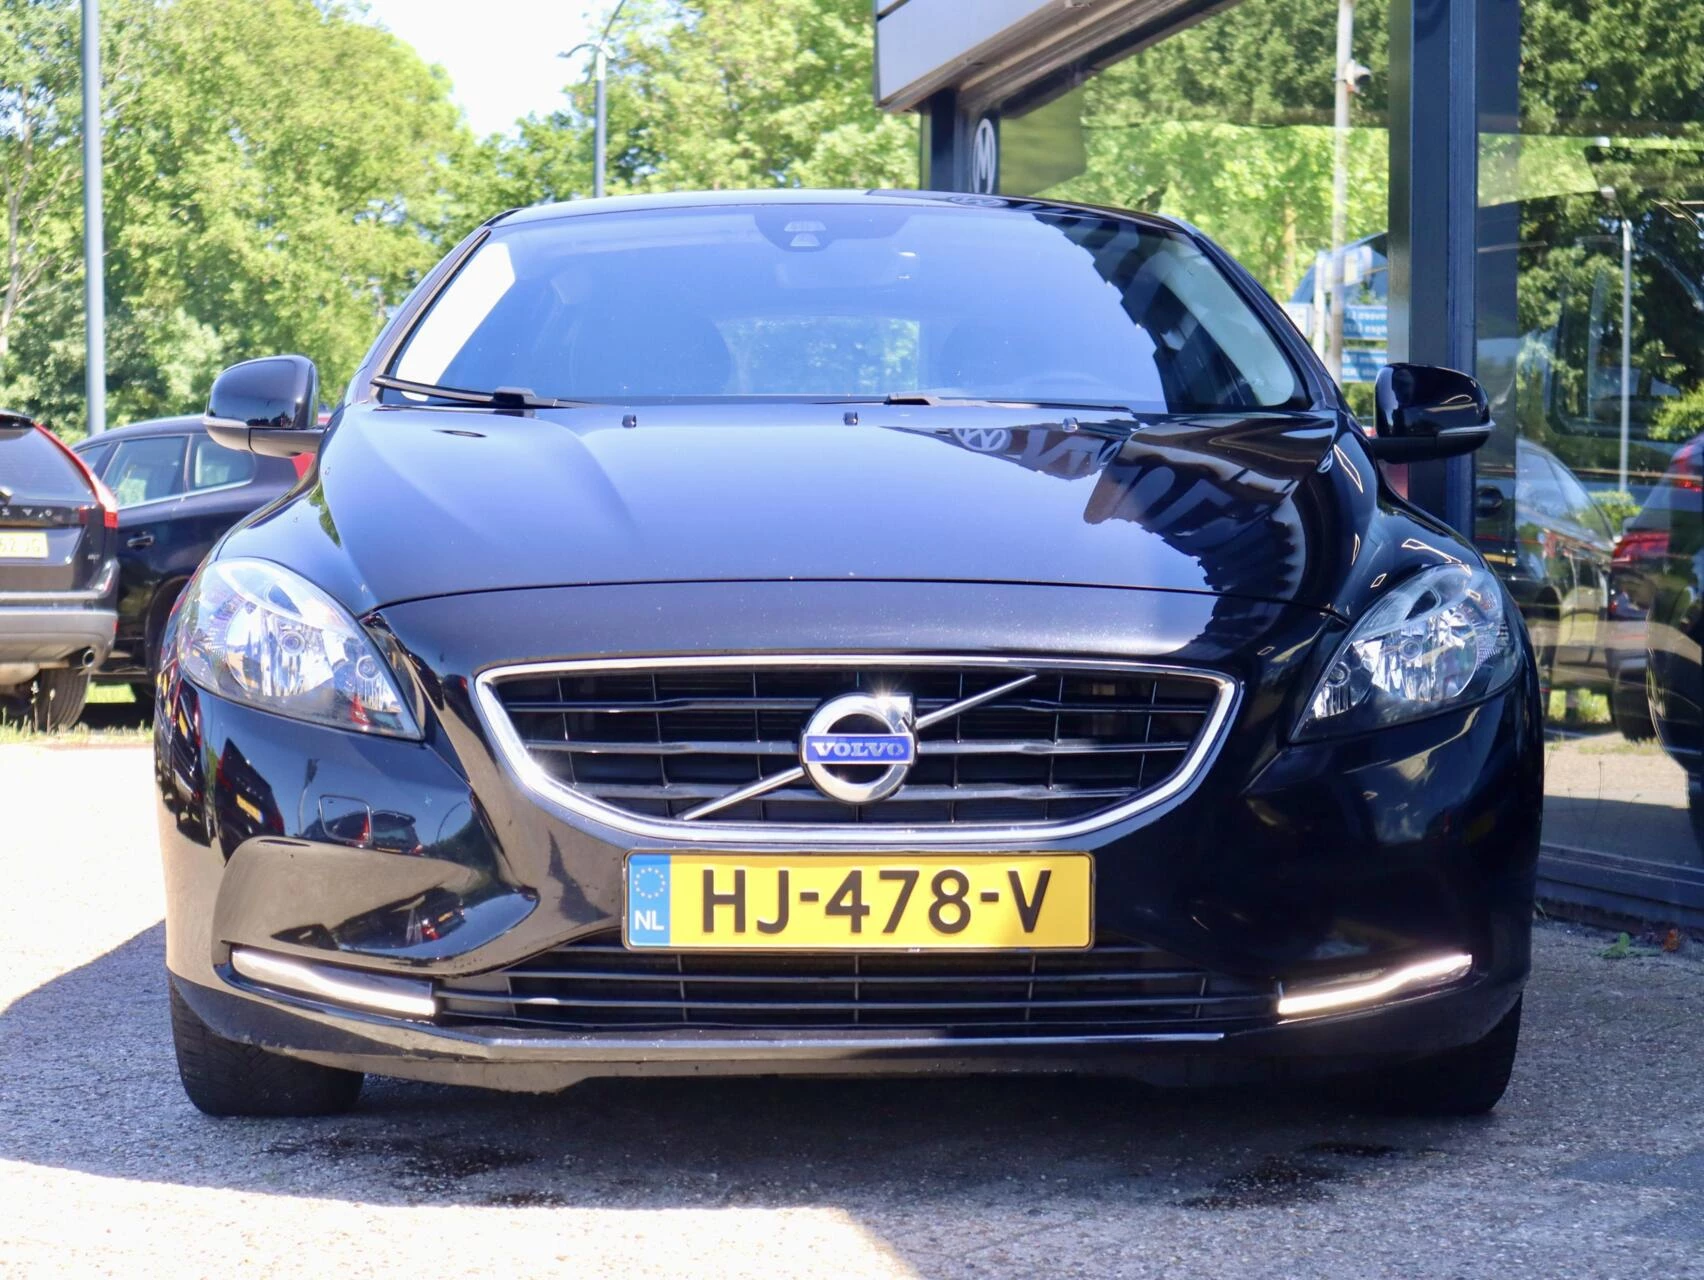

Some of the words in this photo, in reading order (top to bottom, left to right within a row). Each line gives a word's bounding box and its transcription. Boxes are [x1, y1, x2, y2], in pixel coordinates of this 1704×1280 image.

[811, 741, 905, 757] VOLVO
[702, 869, 1052, 935] HJ-478-V
[634, 910, 665, 932] NL
